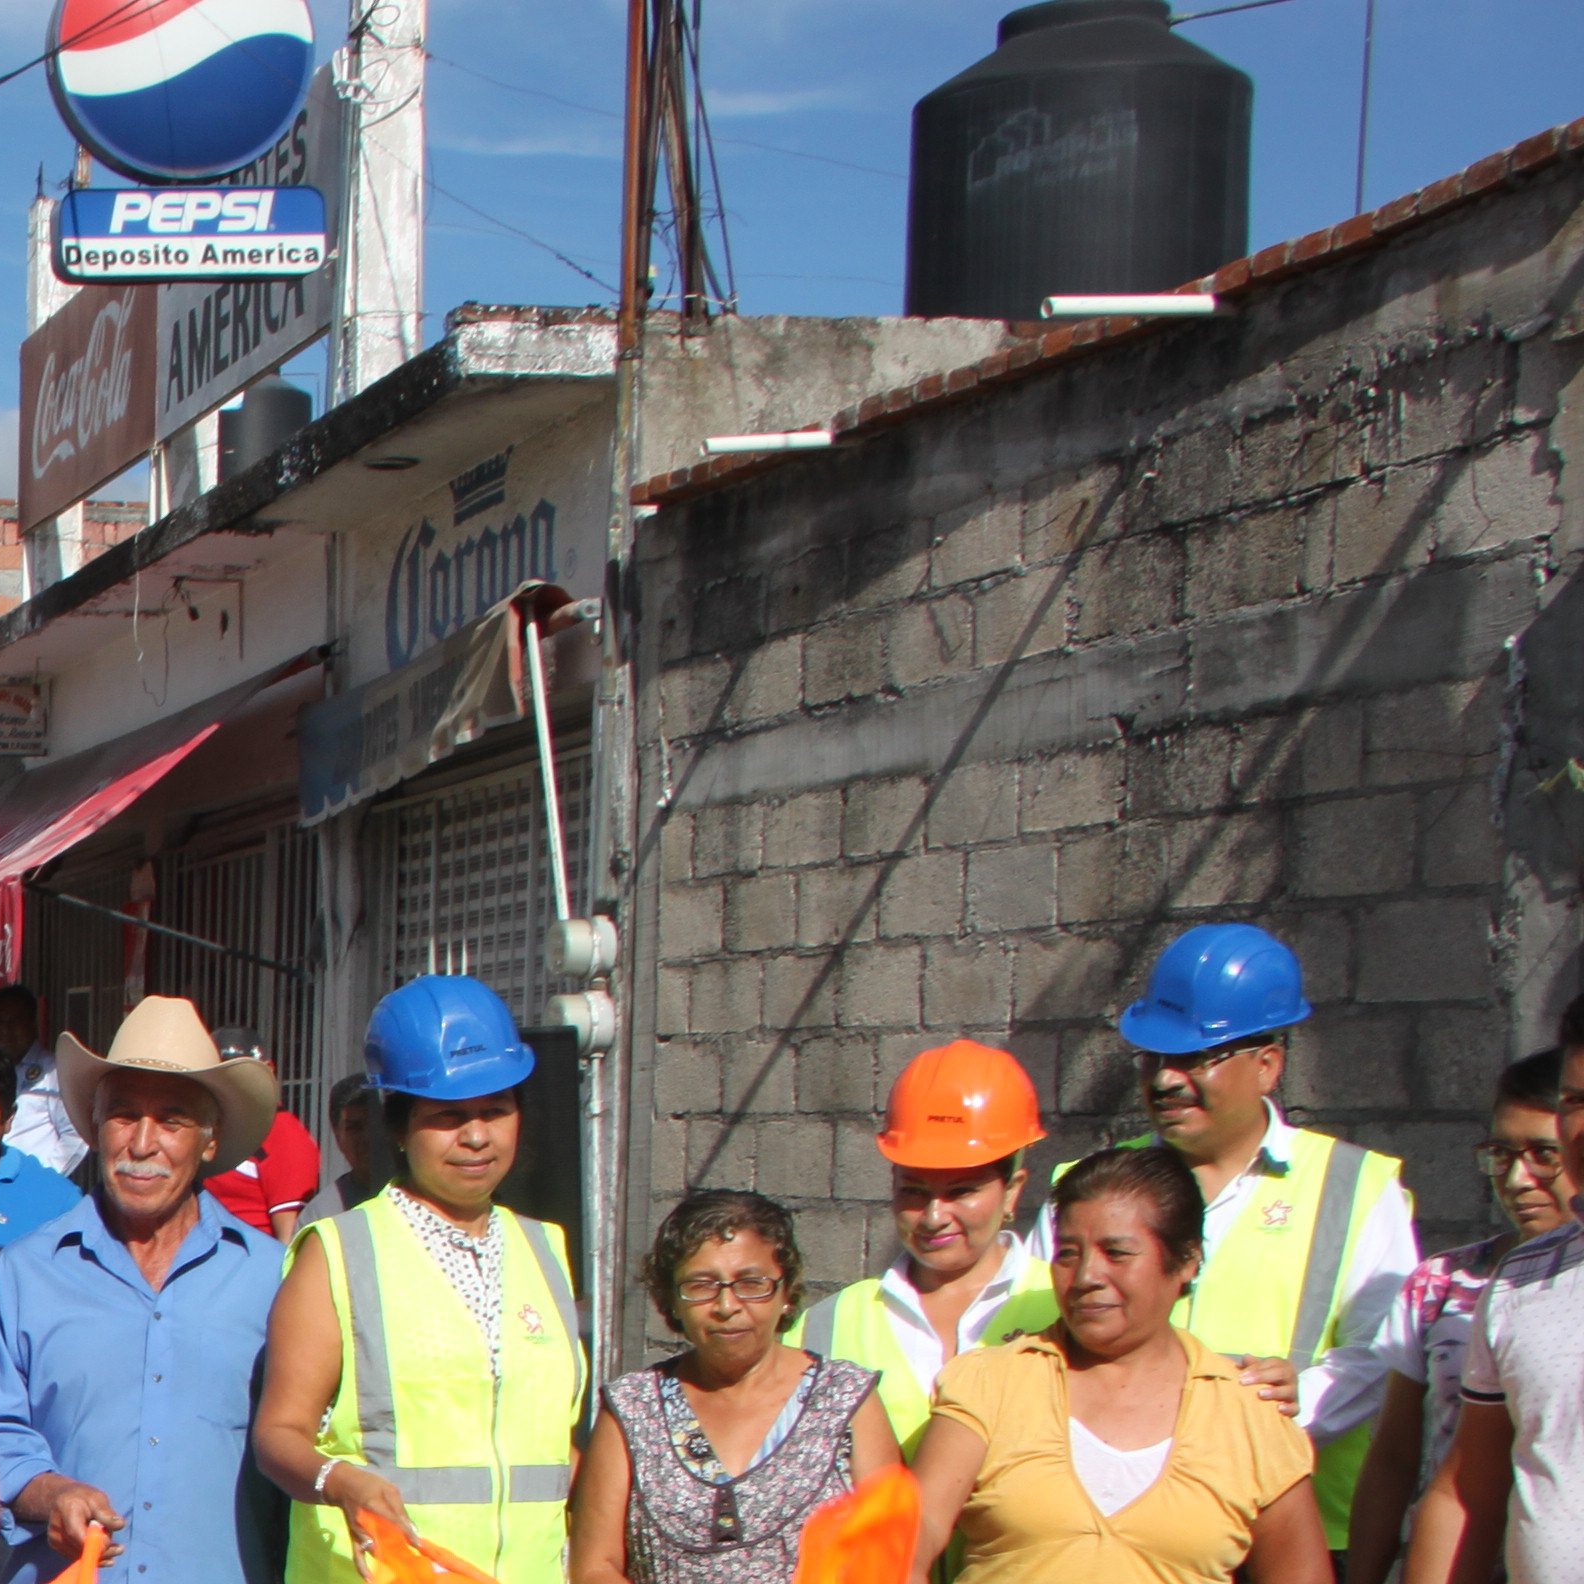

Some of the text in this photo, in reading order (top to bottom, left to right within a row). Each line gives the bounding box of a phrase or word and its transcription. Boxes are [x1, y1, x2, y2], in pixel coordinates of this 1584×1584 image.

[109, 190, 275, 234] PEPSI
[65, 243, 319, 271] Deposito America
[165, 281, 305, 413] AMERICA
[385, 498, 557, 672] Corona
[450, 1044, 487, 1058] PRETUL
[928, 1115, 964, 1124] PRETUL
